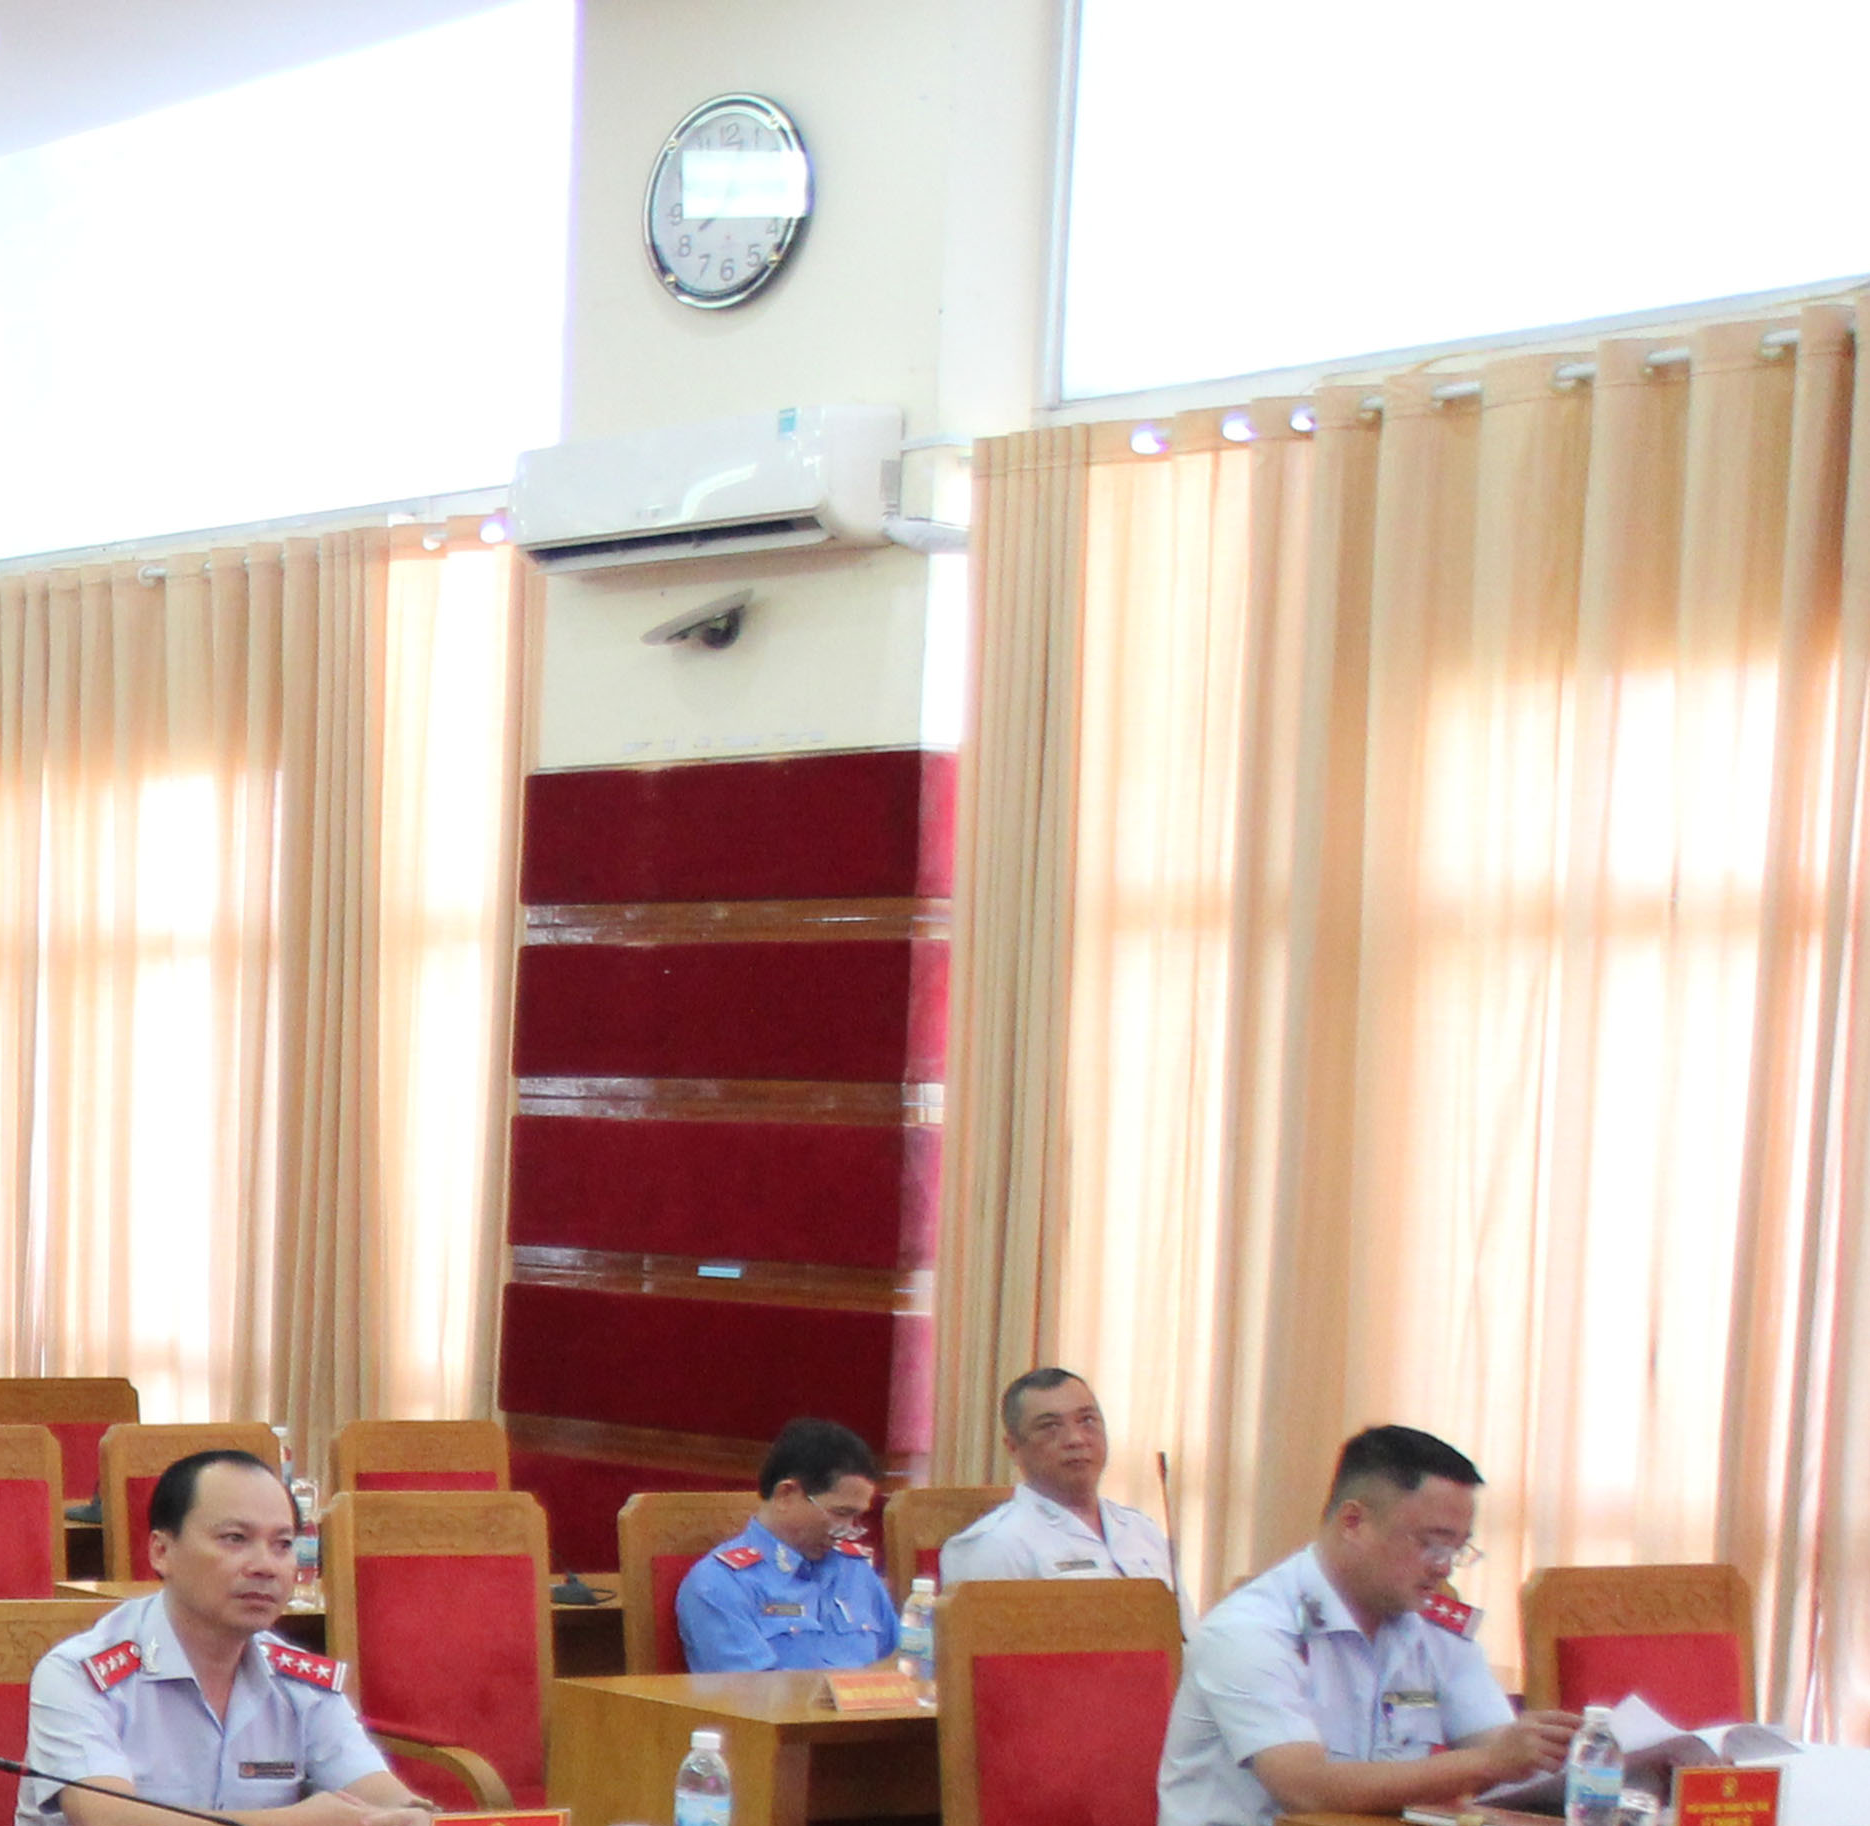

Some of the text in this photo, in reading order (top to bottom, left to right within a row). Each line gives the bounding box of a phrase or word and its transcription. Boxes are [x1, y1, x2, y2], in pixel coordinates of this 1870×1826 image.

[722, 122, 742, 146] 12
[670, 203, 683, 226] 9
[678, 235, 691, 258] 8
[747, 243, 762, 268] 5
[697, 253, 712, 279] 7
[719, 258, 735, 282] 6
